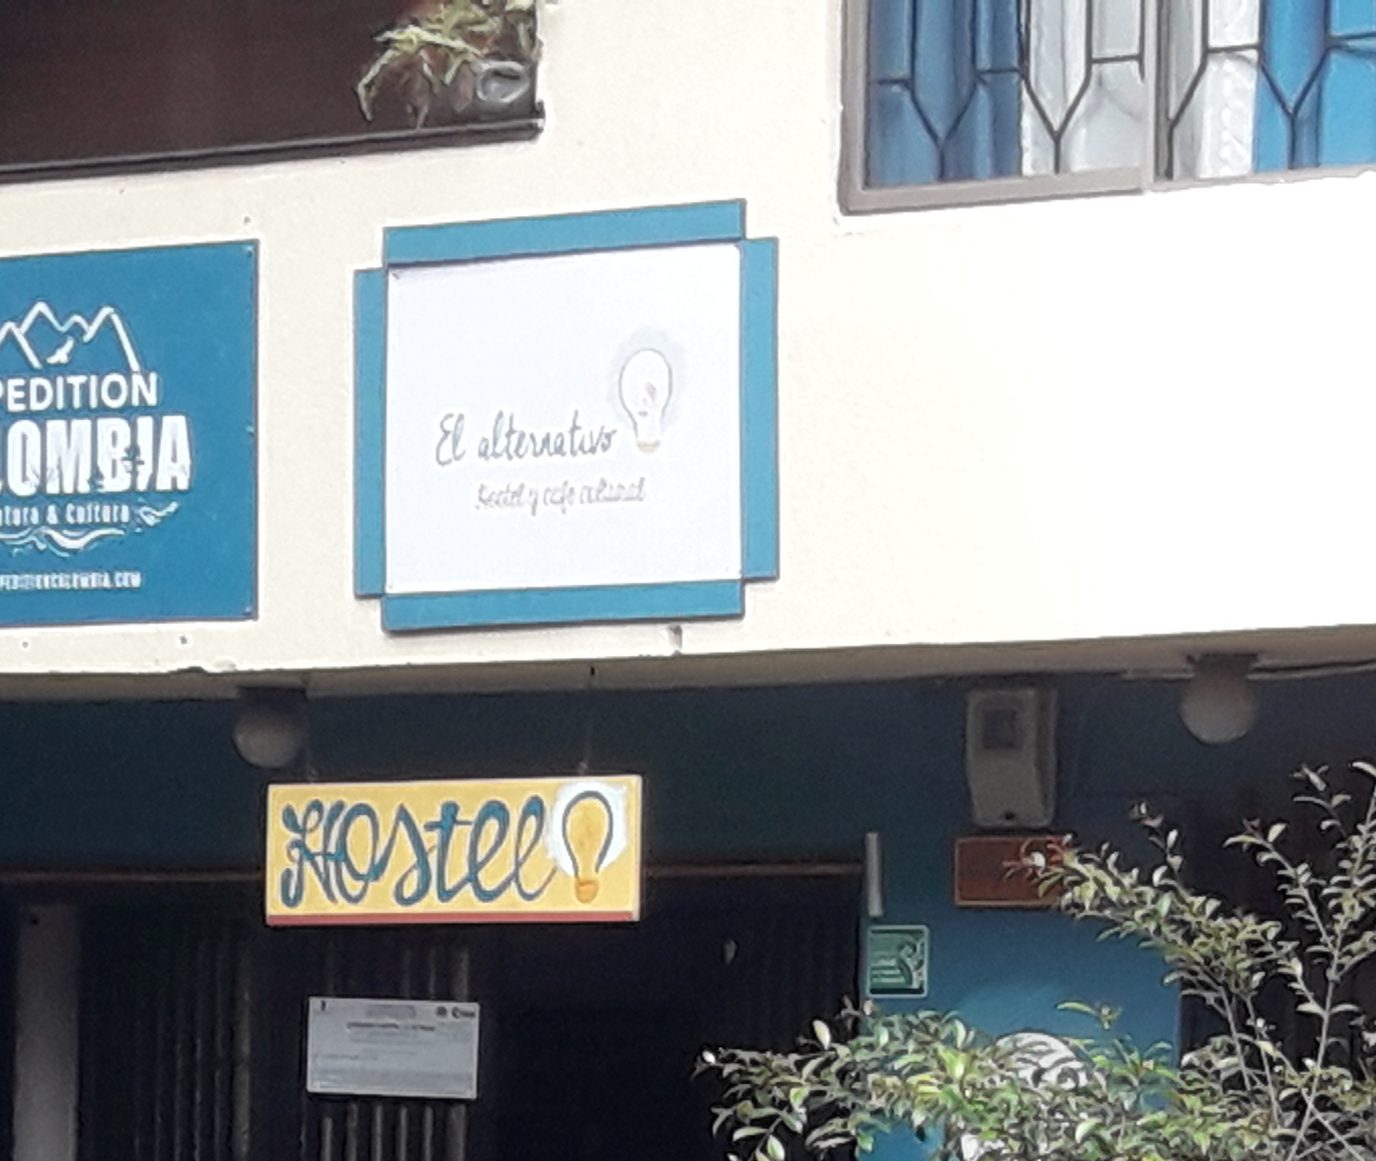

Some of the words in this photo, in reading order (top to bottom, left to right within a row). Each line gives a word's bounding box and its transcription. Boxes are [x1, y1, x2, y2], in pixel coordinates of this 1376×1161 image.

[435, 412, 466, 466] El
[476, 409, 618, 461] alternativo
[46, 503, 58, 525] &
[65, 502, 131, 525] Cultura
